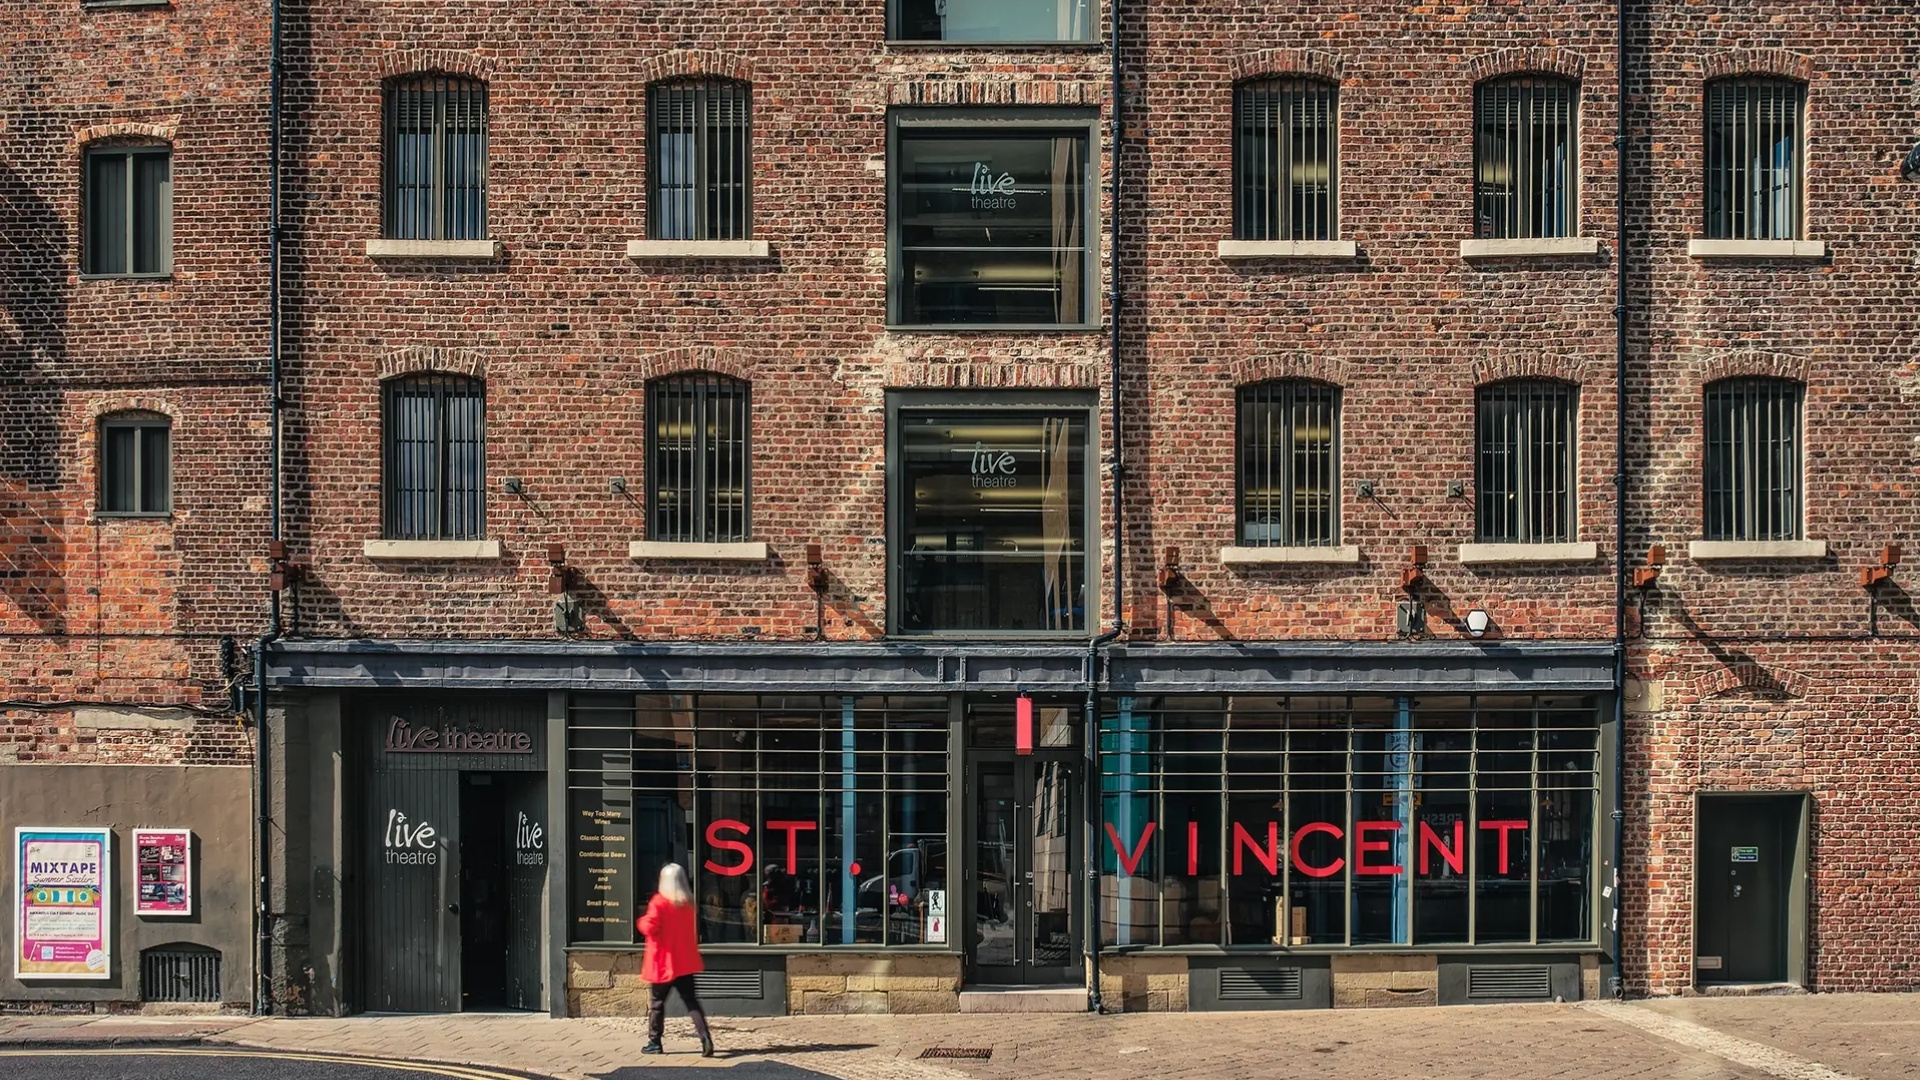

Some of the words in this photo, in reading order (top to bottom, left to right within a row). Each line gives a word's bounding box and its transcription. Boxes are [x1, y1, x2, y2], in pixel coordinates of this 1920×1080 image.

[971, 162, 1015, 195] live
[971, 196, 1016, 209] theatre
[971, 441, 1016, 474] live
[971, 474, 1016, 488] theatre
[386, 715, 439, 749] live
[442, 726, 531, 750] theatre
[385, 808, 437, 849] live
[516, 811, 543, 849] live
[600, 834, 626, 842] Cocktails
[579, 850, 610, 858] Continental
[1104, 821, 1528, 877] VINCENT
[385, 849, 437, 865] theatre
[516, 851, 544, 865] theatre
[30, 861, 97, 874] MIXTAPE
[33, 873, 64, 883] Summer
